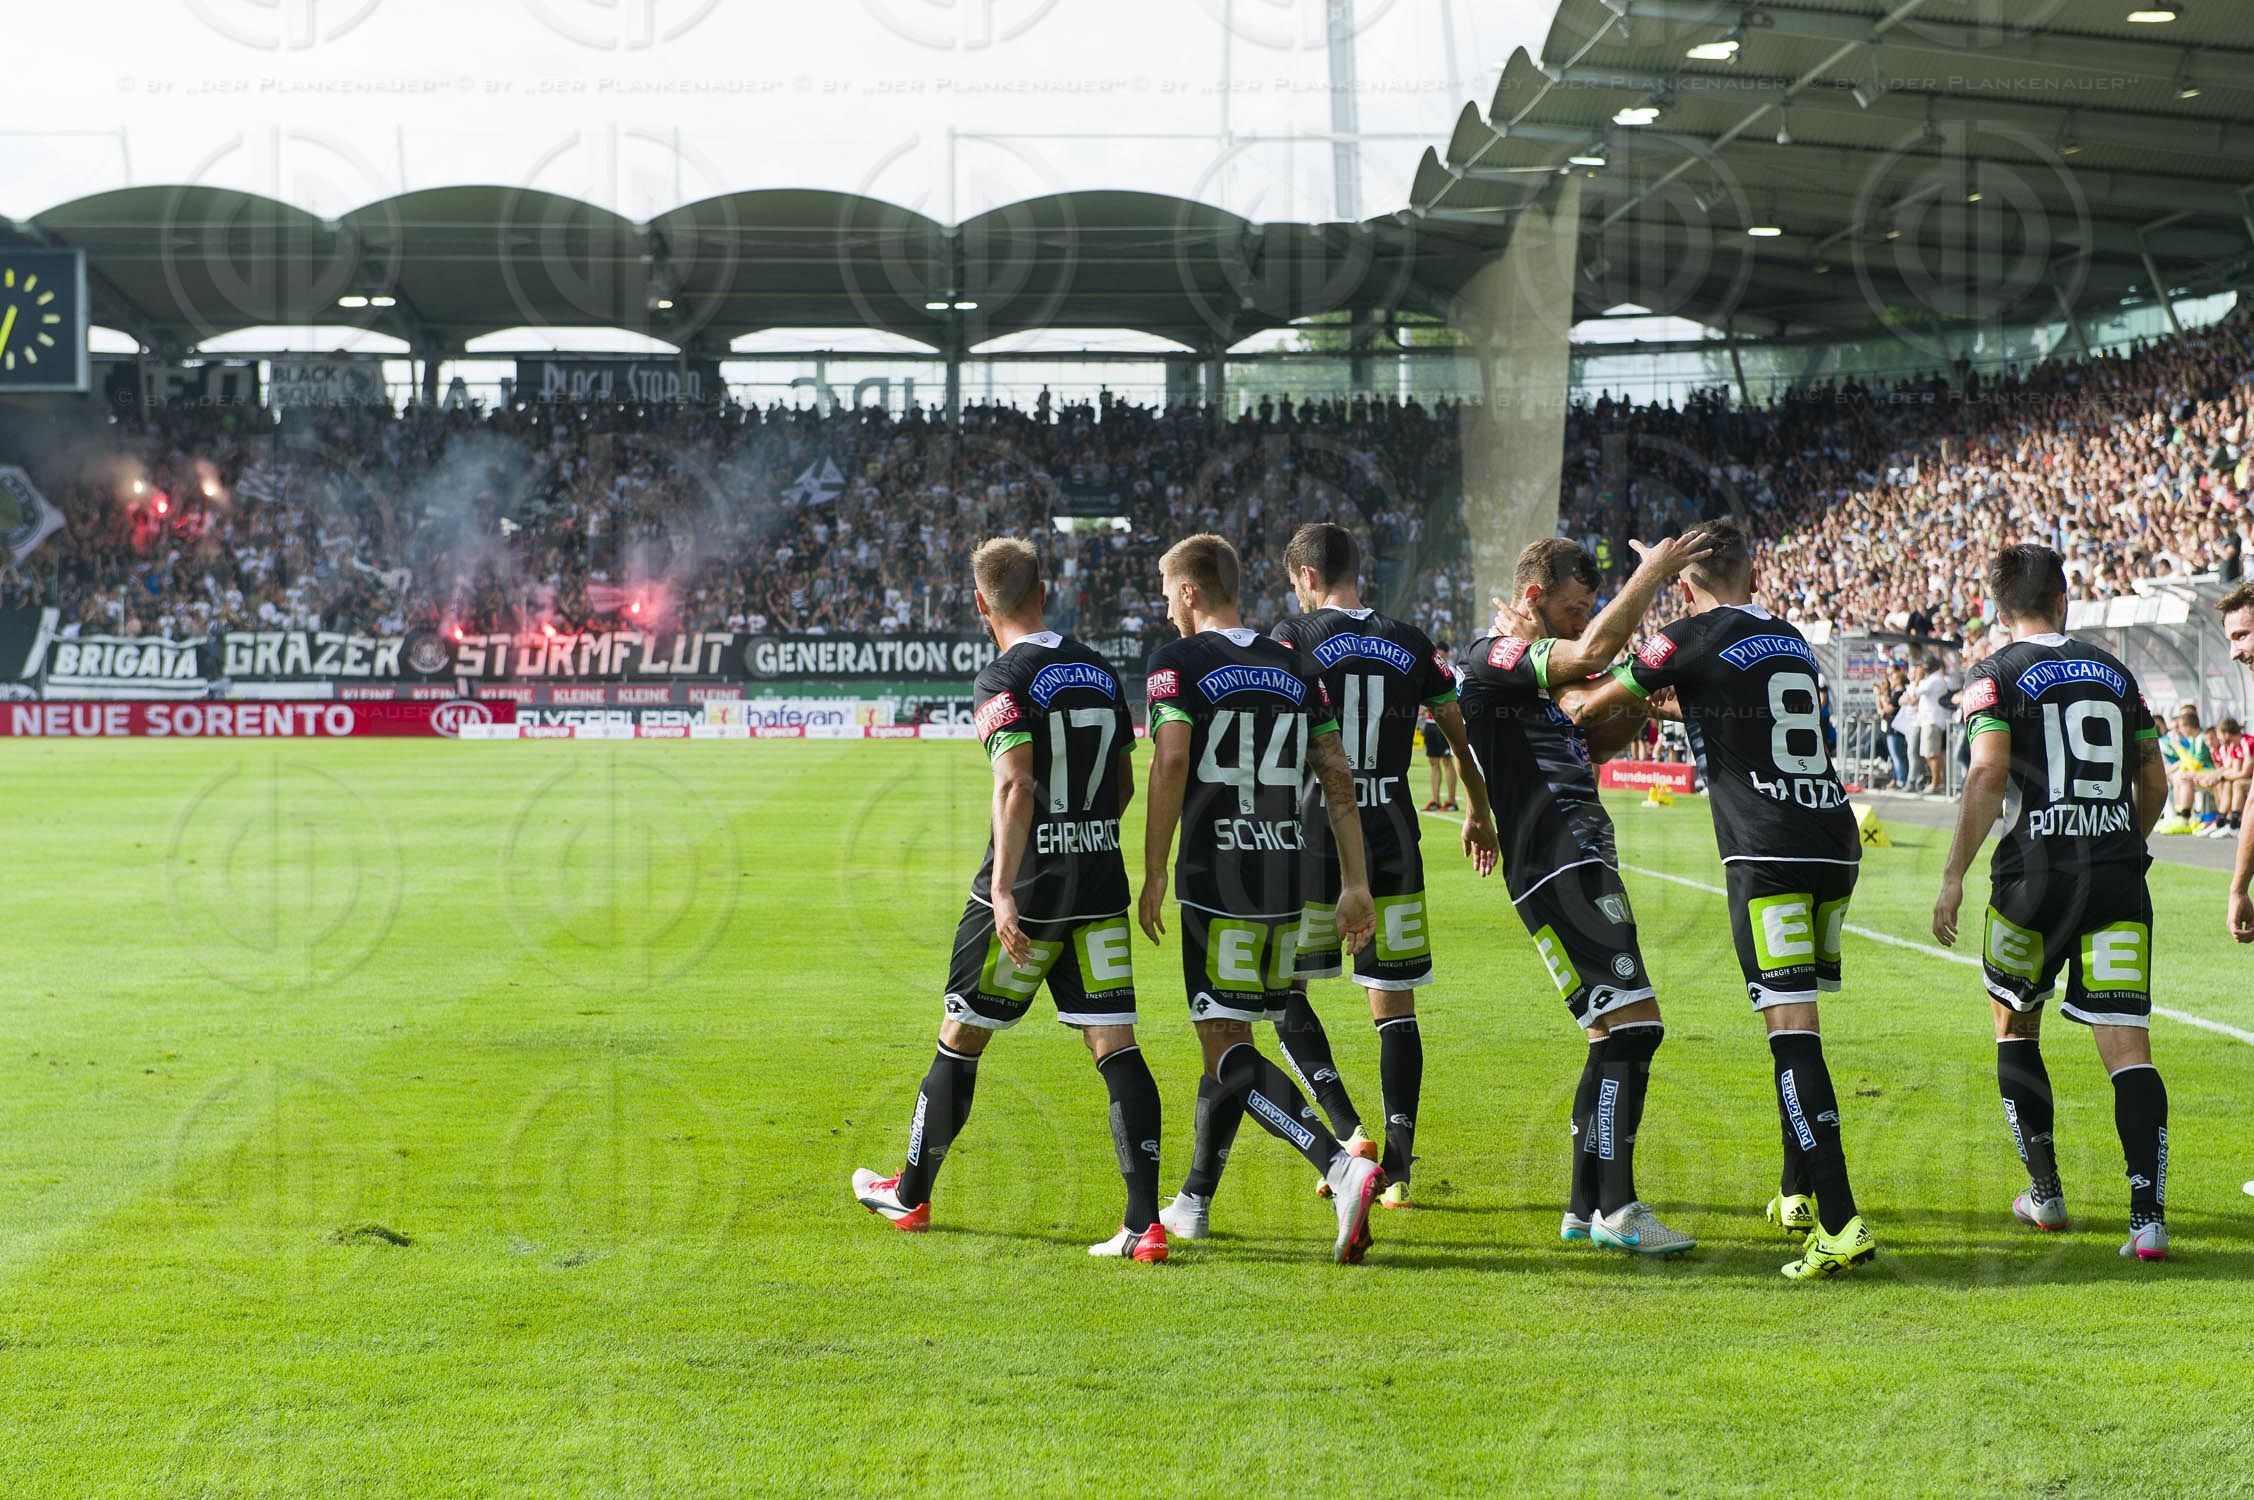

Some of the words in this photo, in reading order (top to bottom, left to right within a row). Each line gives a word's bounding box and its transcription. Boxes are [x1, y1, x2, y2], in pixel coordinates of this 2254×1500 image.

[53, 642, 199, 679] BRIGATA
[224, 632, 404, 677] GRAZER
[755, 641, 948, 673] GENERATION
[1728, 638, 1818, 668] PUNTIGAME
[2023, 664, 2122, 693] PUNTIGAMER
[1205, 669, 1302, 699] PUNTIGAMER
[11, 704, 130, 736] NEUE
[145, 704, 355, 737] SORENTO
[1342, 673, 1385, 770] 11
[1767, 671, 1828, 775] 8
[1049, 707, 1117, 814] 17
[1196, 710, 1309, 815] 44
[2042, 699, 2123, 803] 19
[1612, 769, 1687, 786] bundesliga.at
[2029, 802, 2131, 840] POTZMANN
[1383, 900, 1425, 952] E
[1762, 902, 1813, 958] E
[1990, 919, 2033, 970] E
[993, 942, 1050, 993] E
[1085, 927, 1133, 981] E
[1218, 928, 1257, 982] E
[1761, 968, 1791, 980] ENERGIE
[2092, 930, 2142, 981] E
[1085, 990, 1115, 999] ENERGIE
[1251, 1095, 1310, 1146] PUNTIGAMER
[1600, 1084, 1615, 1155] PUNTIGAMER
[1783, 1075, 1811, 1145] PUNTIGAMER
